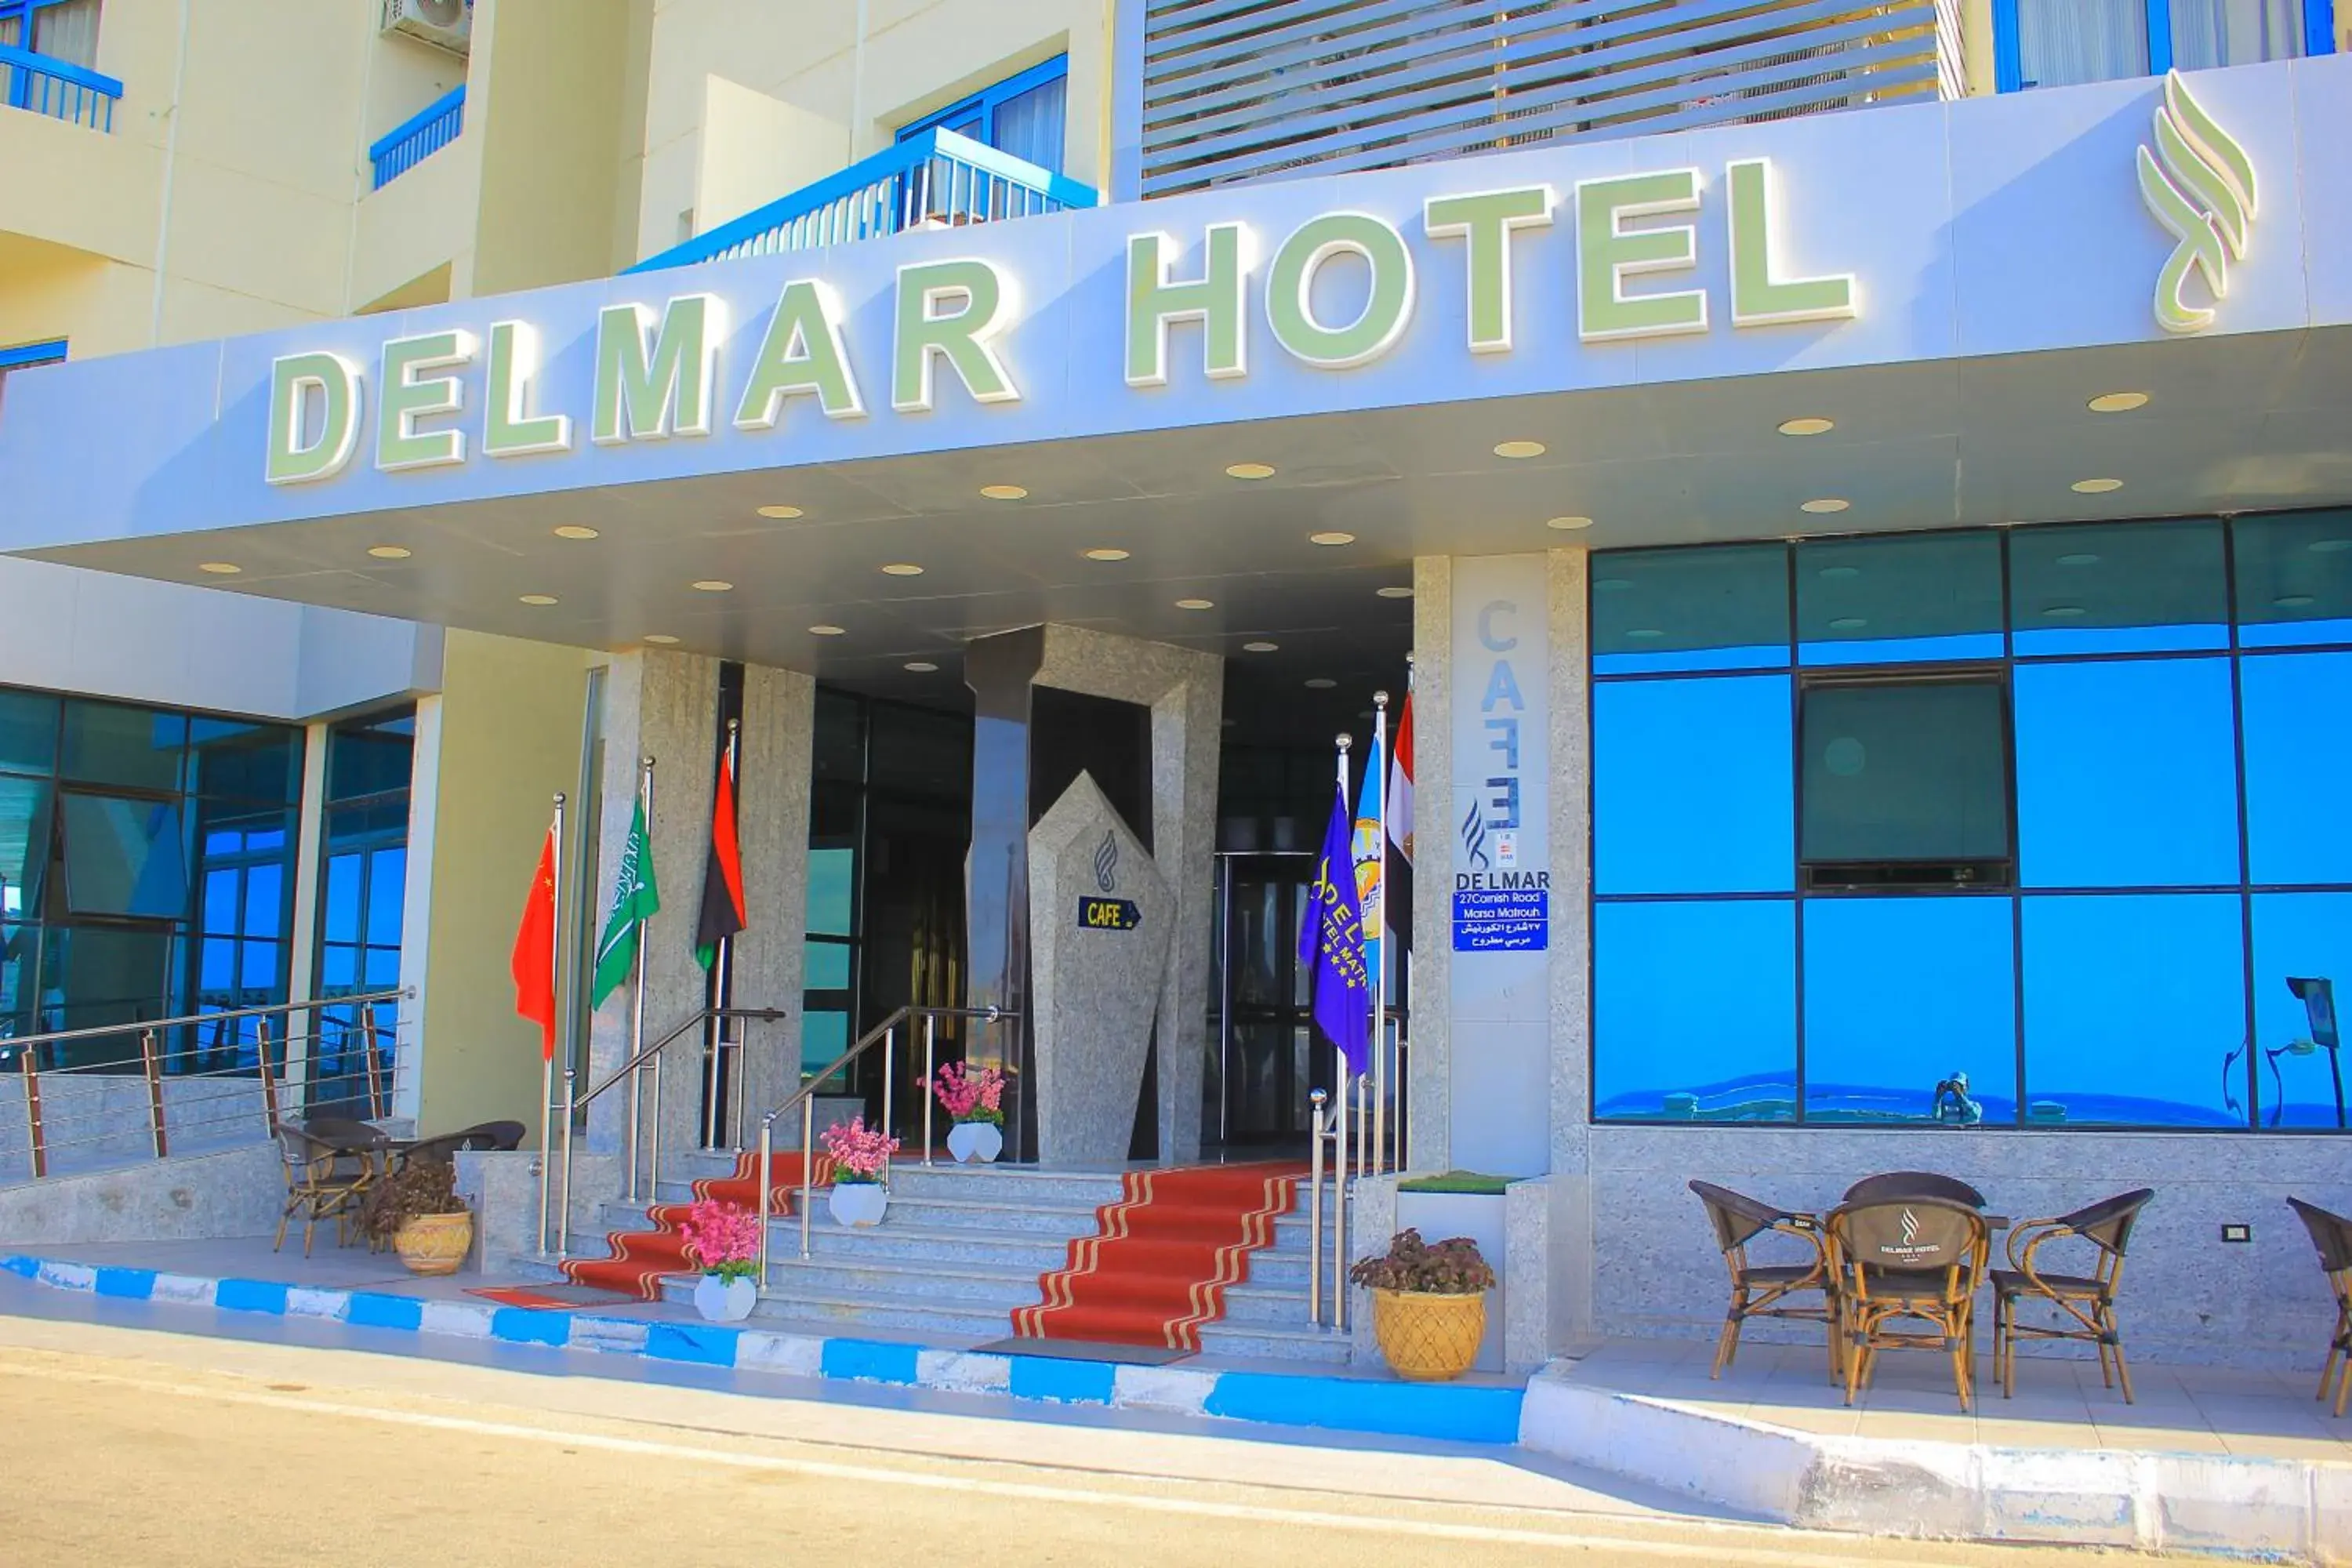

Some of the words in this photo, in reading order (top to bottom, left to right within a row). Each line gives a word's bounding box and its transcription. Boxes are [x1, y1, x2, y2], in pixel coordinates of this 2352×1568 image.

[264, 256, 1022, 485] DELMAR
[1124, 156, 1857, 387] HOTEL
[1456, 872, 1550, 890] DELMAR
[1512, 892, 1541, 903] Road
[1087, 903, 1121, 927] CAFE
[1464, 909, 1495, 919] Marsa
[1497, 906, 1541, 918] Matrouh
